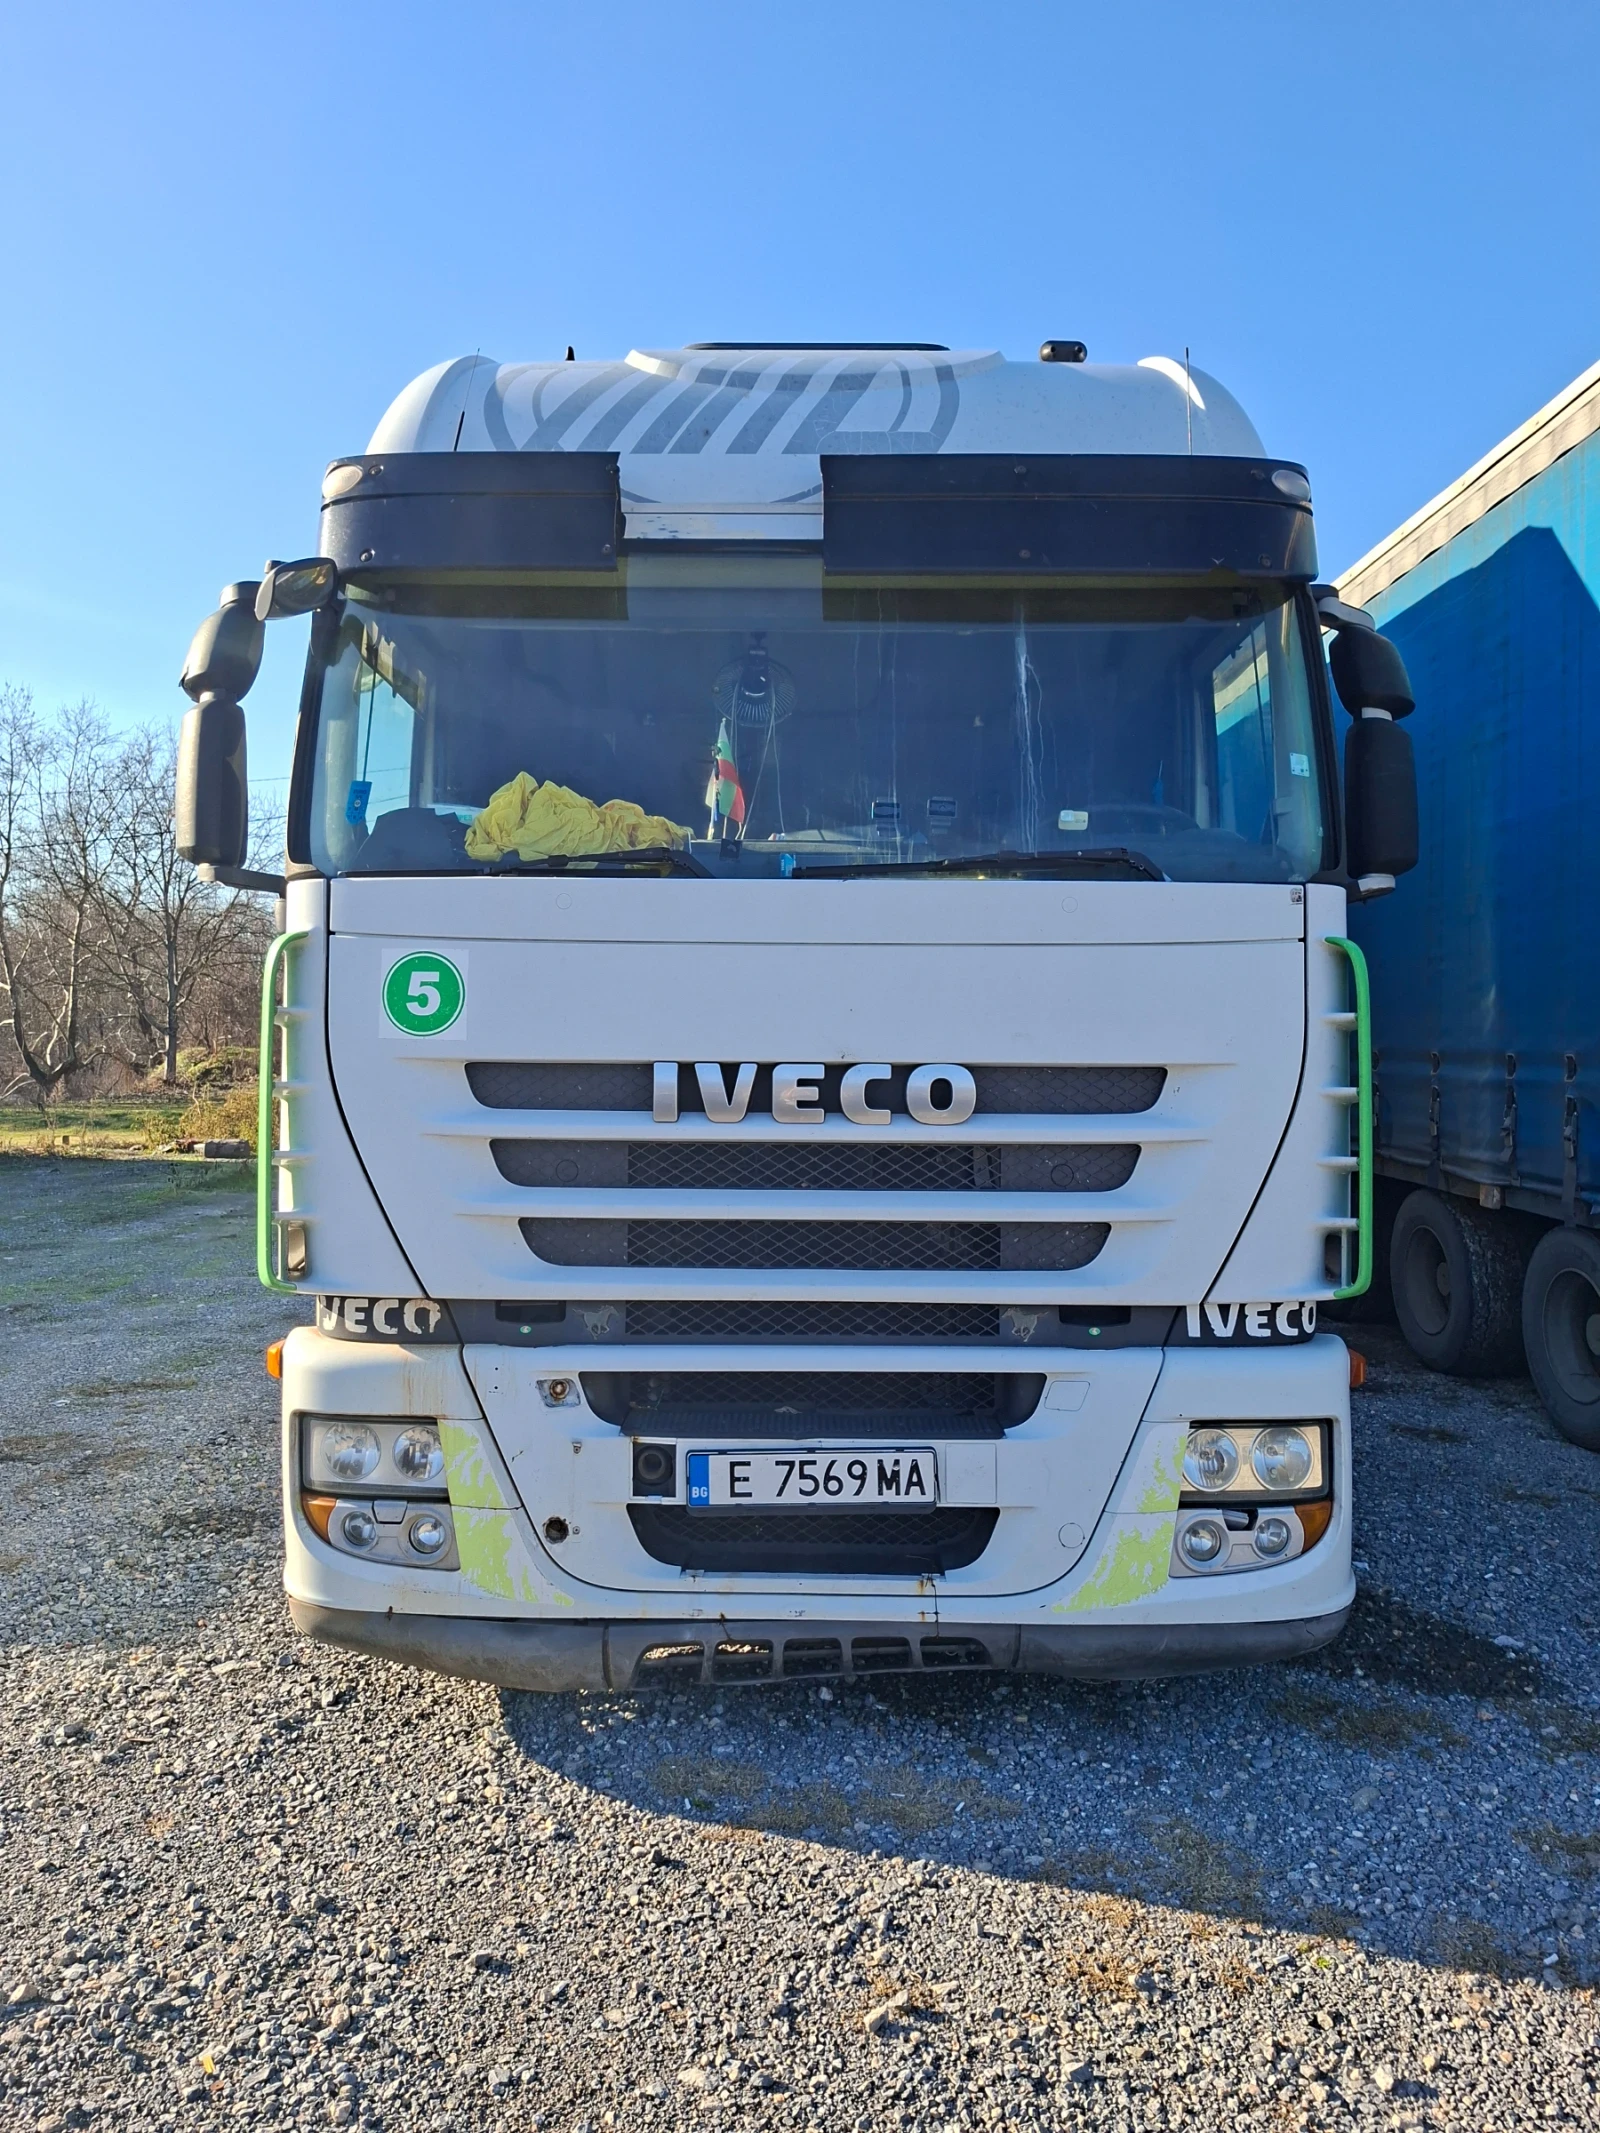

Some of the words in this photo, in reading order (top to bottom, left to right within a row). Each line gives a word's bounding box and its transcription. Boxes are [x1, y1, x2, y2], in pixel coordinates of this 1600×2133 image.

[406, 971, 441, 1016] 5
[652, 1061, 977, 1125] IVECO
[316, 1295, 441, 1334] VECO
[1186, 1301, 1317, 1338] IVECO
[691, 1486, 709, 1498] BG
[729, 1460, 753, 1498] E
